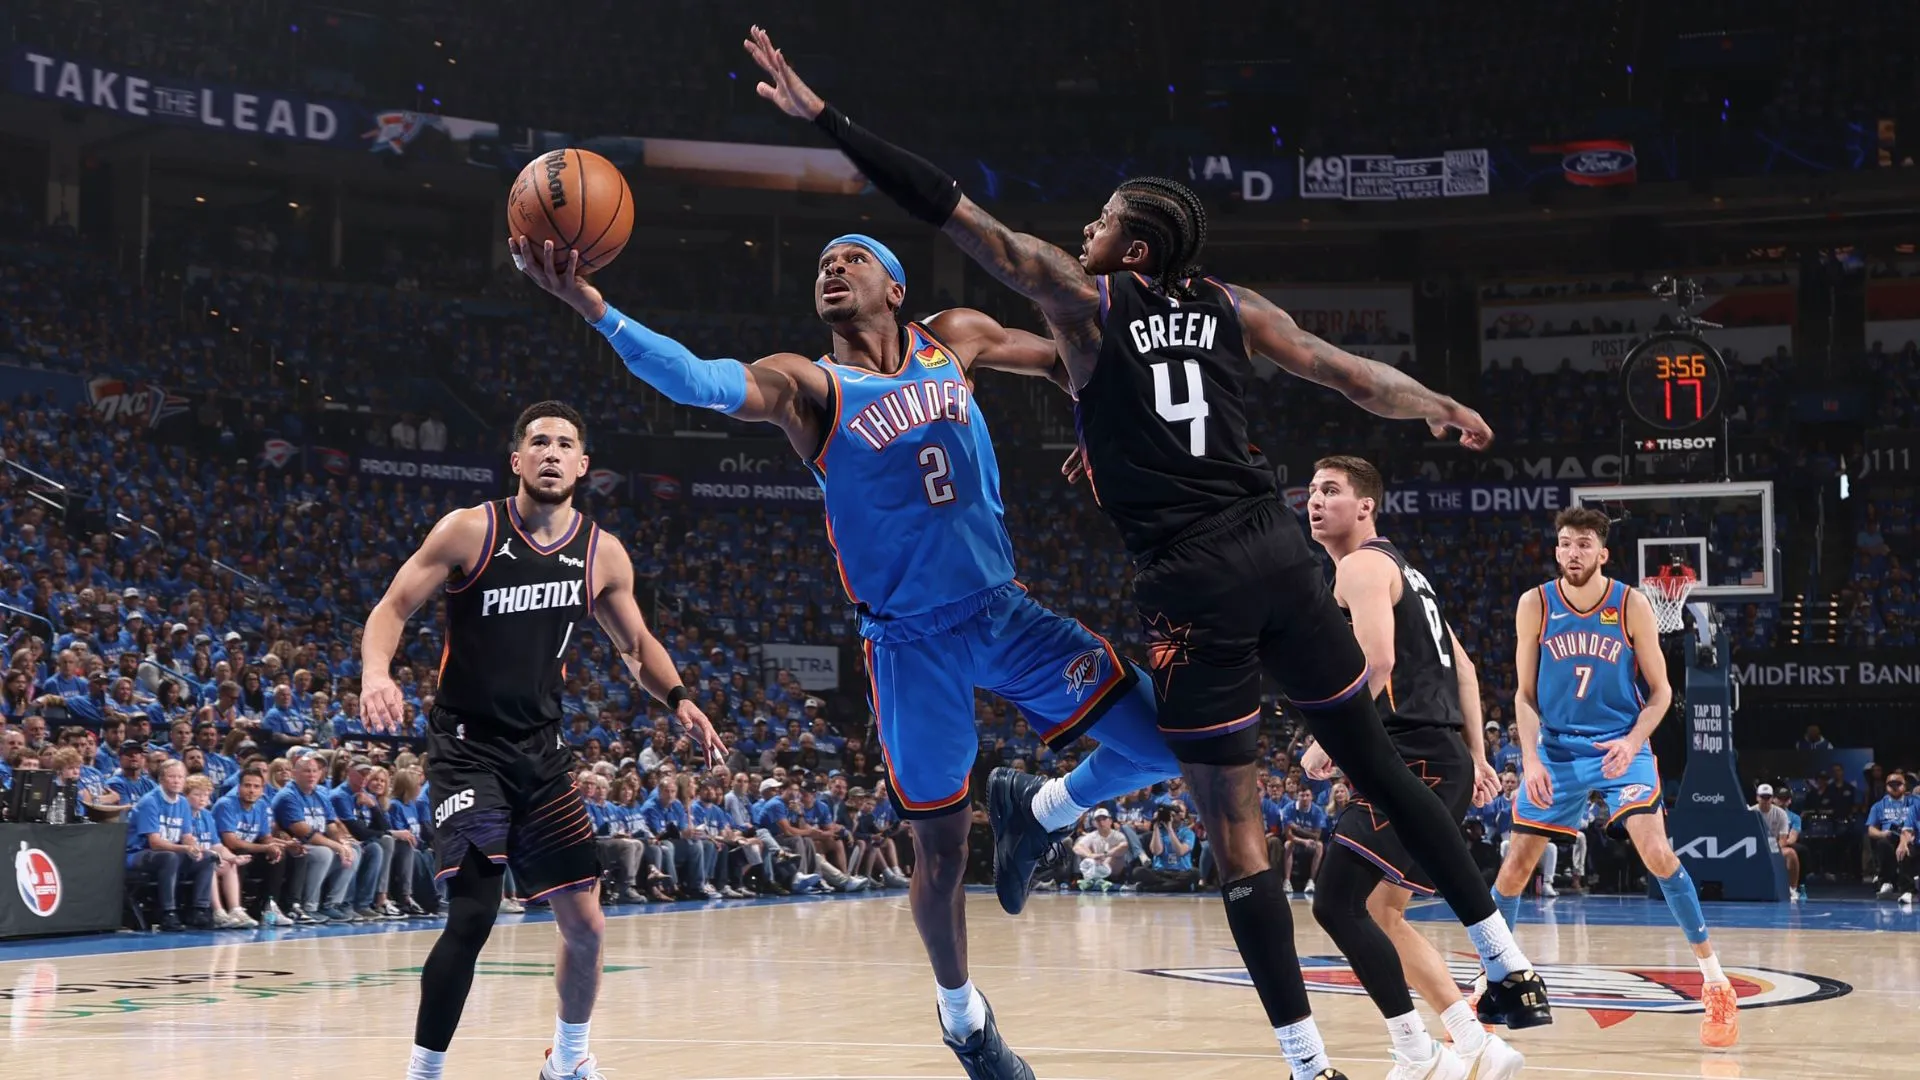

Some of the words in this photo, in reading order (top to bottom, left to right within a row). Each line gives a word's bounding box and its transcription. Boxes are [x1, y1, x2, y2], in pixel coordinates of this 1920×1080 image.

[26, 52, 150, 116] TAKE
[153, 86, 198, 118] THE
[200, 88, 337, 141] LEAD
[1306, 156, 1345, 182] 49
[1129, 312, 1218, 354] GREEN
[1656, 355, 1706, 378] 3:56
[1150, 358, 1209, 457] 4
[1664, 379, 1703, 420] 17
[849, 381, 969, 452] THUNDER
[1657, 437, 1716, 450] TISSOT
[360, 458, 418, 478] PROUD
[420, 463, 494, 483] PARTNER
[918, 444, 955, 504] 2
[691, 482, 749, 499] PROUD
[1427, 491, 1462, 509] THE
[1471, 486, 1560, 512] DRIVE
[559, 554, 584, 568] PayPal
[482, 579, 583, 616] PHOENIX
[1545, 632, 1622, 664] THUNDER
[1575, 666, 1592, 698] 7
[1694, 704, 1707, 718] TAP
[1710, 704, 1722, 718] TO
[1694, 718, 1722, 732] WATCH
[1702, 733, 1723, 753] App
[1692, 792, 1725, 804] Google
